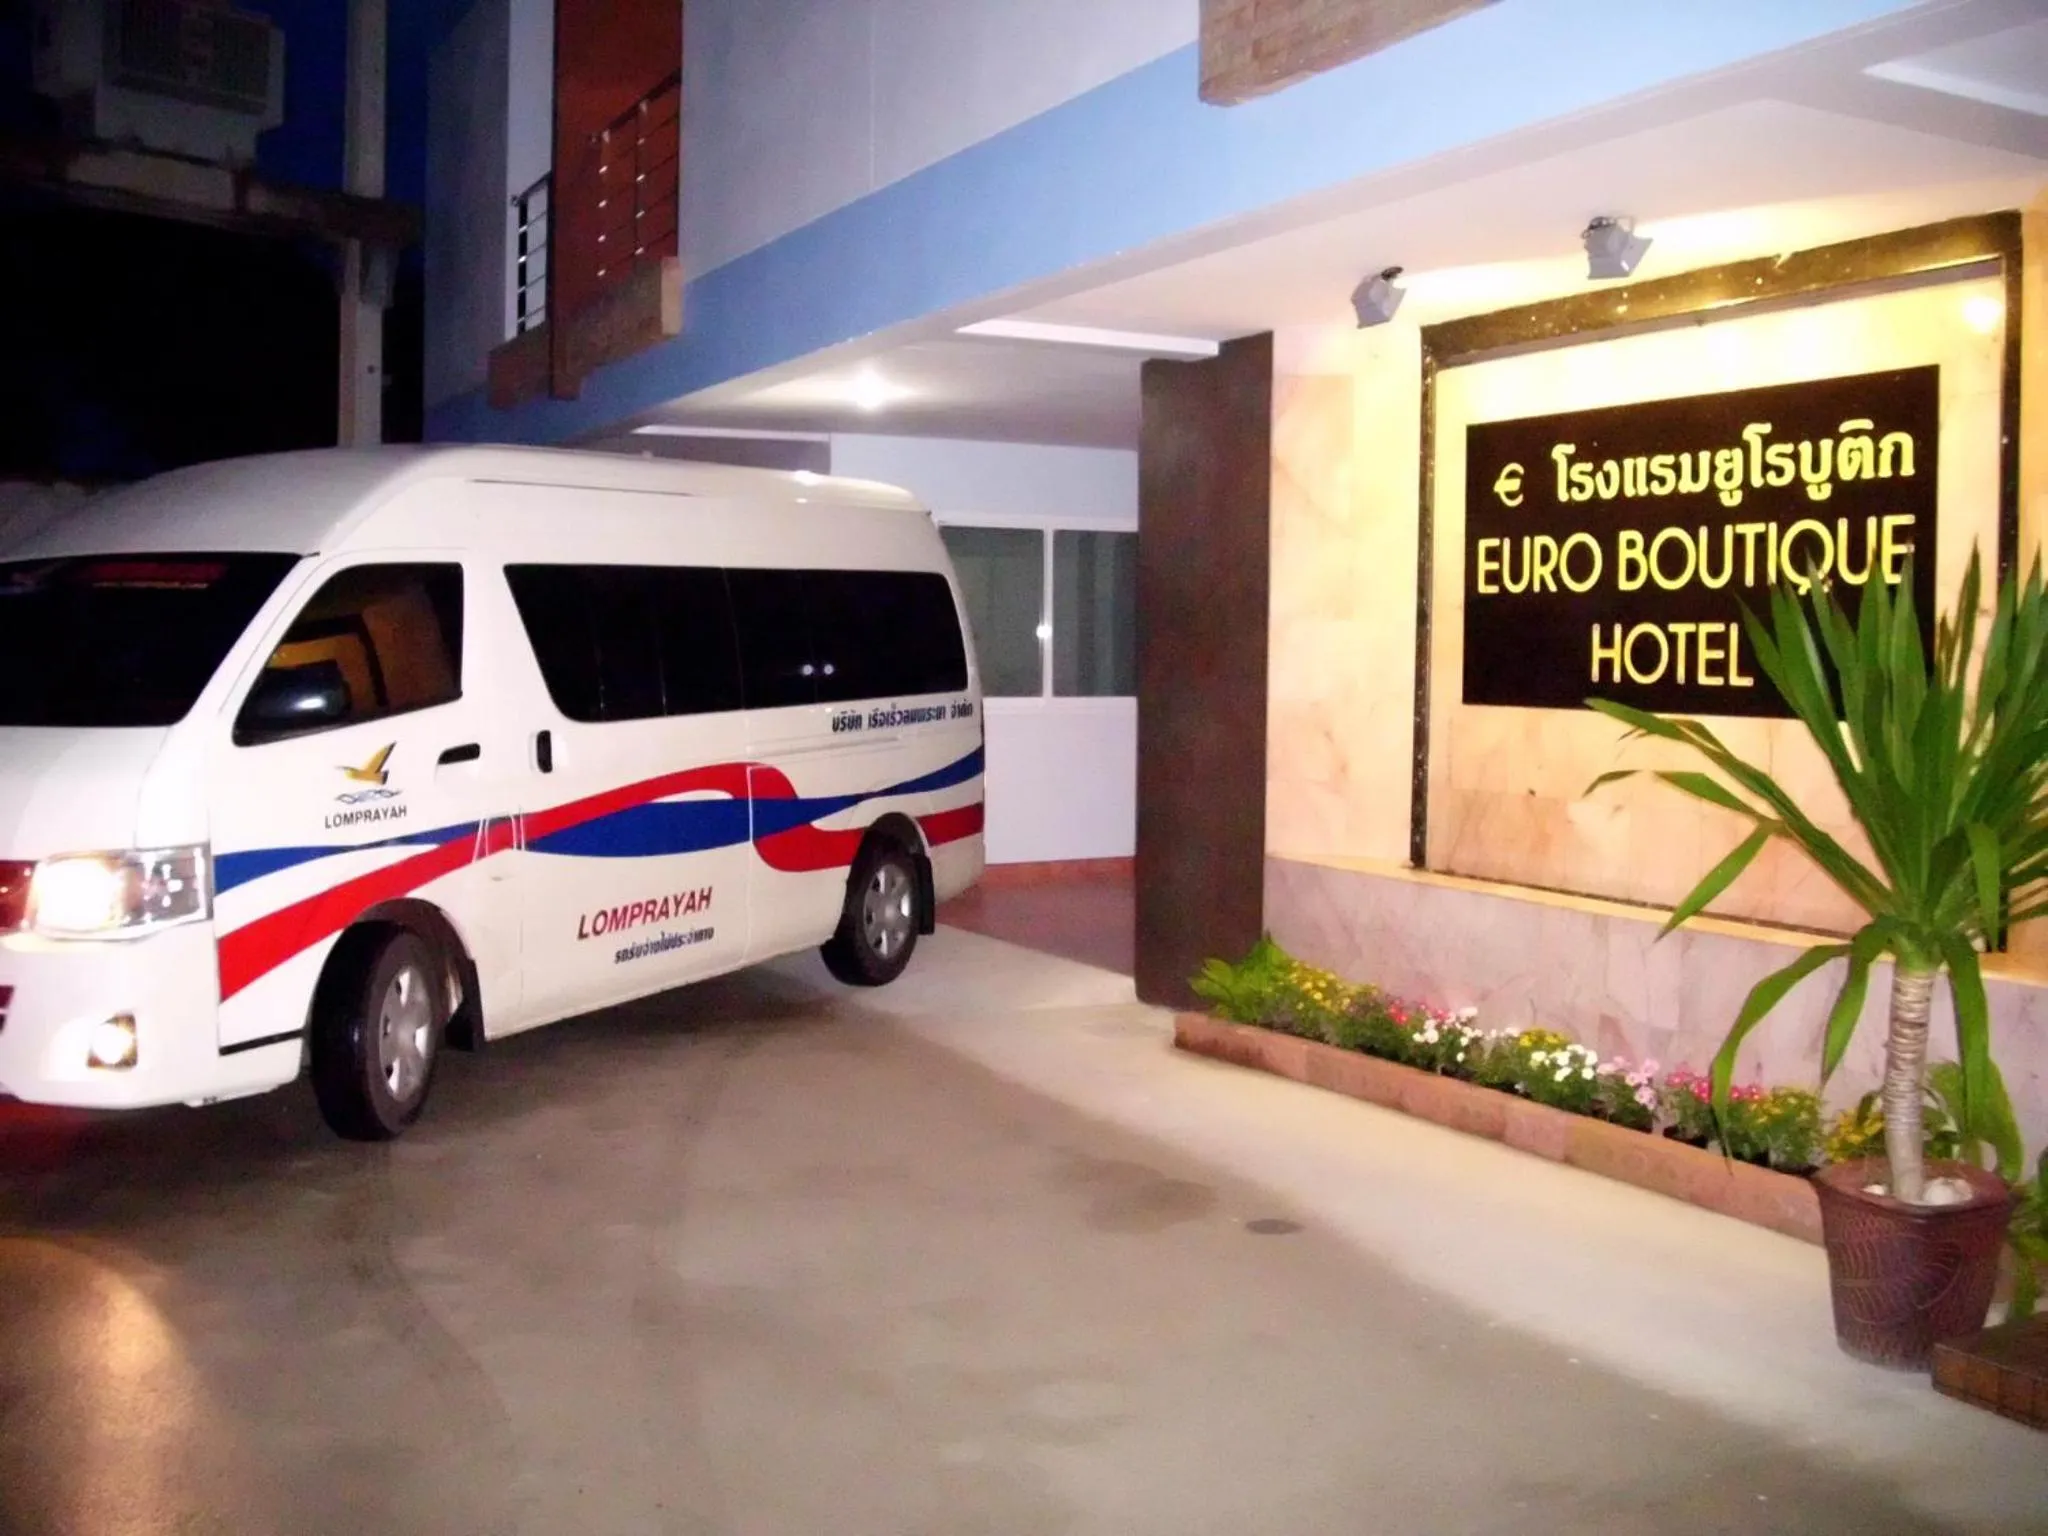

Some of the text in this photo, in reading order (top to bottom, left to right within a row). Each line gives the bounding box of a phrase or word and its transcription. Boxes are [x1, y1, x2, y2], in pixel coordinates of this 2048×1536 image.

[1551, 418, 1915, 507] โรงแรมยูโรบูติก
[1477, 514, 1916, 595] EURO BOUTIQUE
[1591, 622, 1754, 687] HOTEL
[324, 805, 408, 829] LOMPRAYAH
[577, 886, 713, 941] LOMPRAYAH
